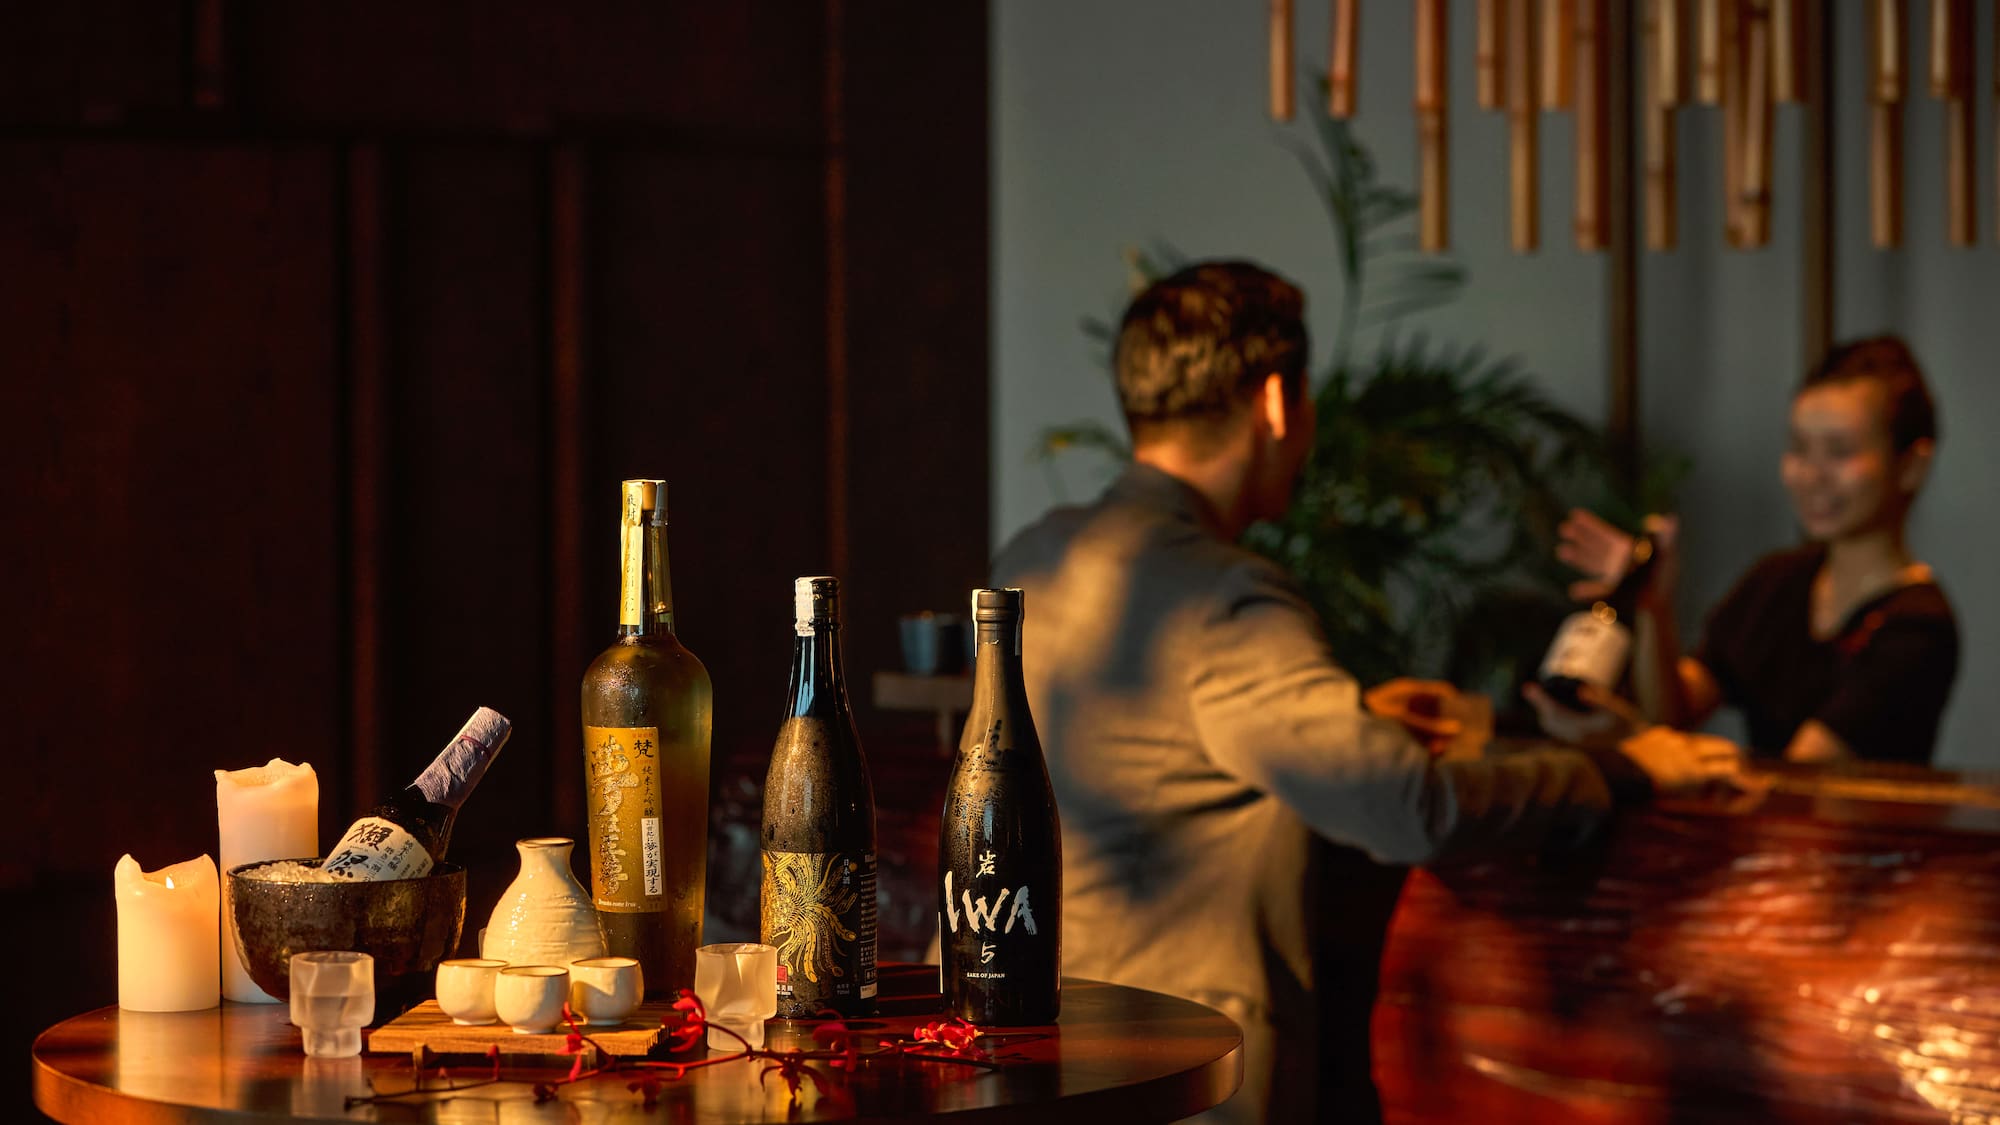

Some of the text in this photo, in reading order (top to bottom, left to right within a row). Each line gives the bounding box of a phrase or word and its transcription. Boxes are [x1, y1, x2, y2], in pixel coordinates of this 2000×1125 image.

[634, 739, 654, 758] 梵
[642, 766, 655, 817] 純米大吟醸
[976, 850, 997, 878] 岩
[944, 870, 1038, 935] IWA
[980, 942, 997, 964] 5
